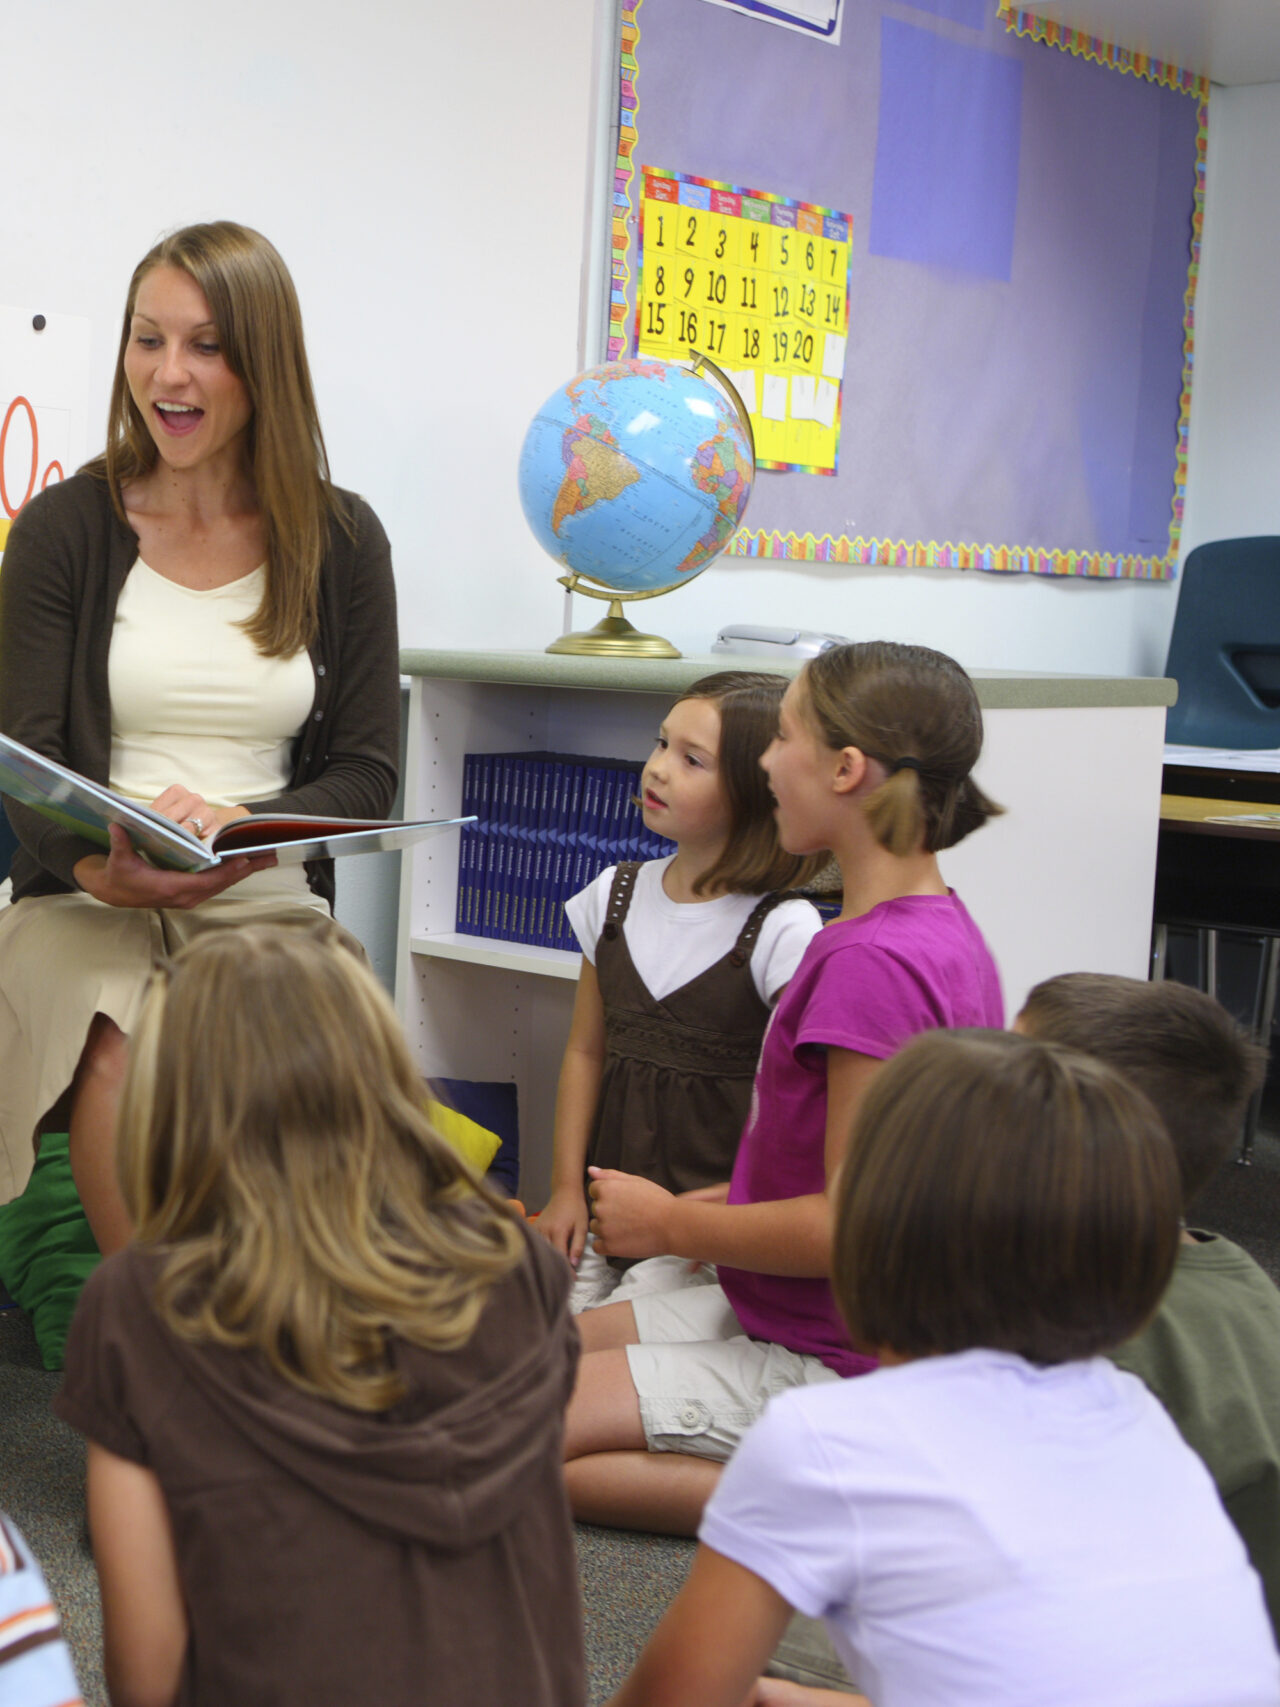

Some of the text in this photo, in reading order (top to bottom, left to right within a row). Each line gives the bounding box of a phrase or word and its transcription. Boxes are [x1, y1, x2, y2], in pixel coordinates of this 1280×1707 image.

[656, 216, 838, 277] 1 2 3 4 5 6 7
[655, 265, 841, 326] 8 9 10 11 12 13 14
[646, 301, 814, 364] 15 16 17 18 19 20
